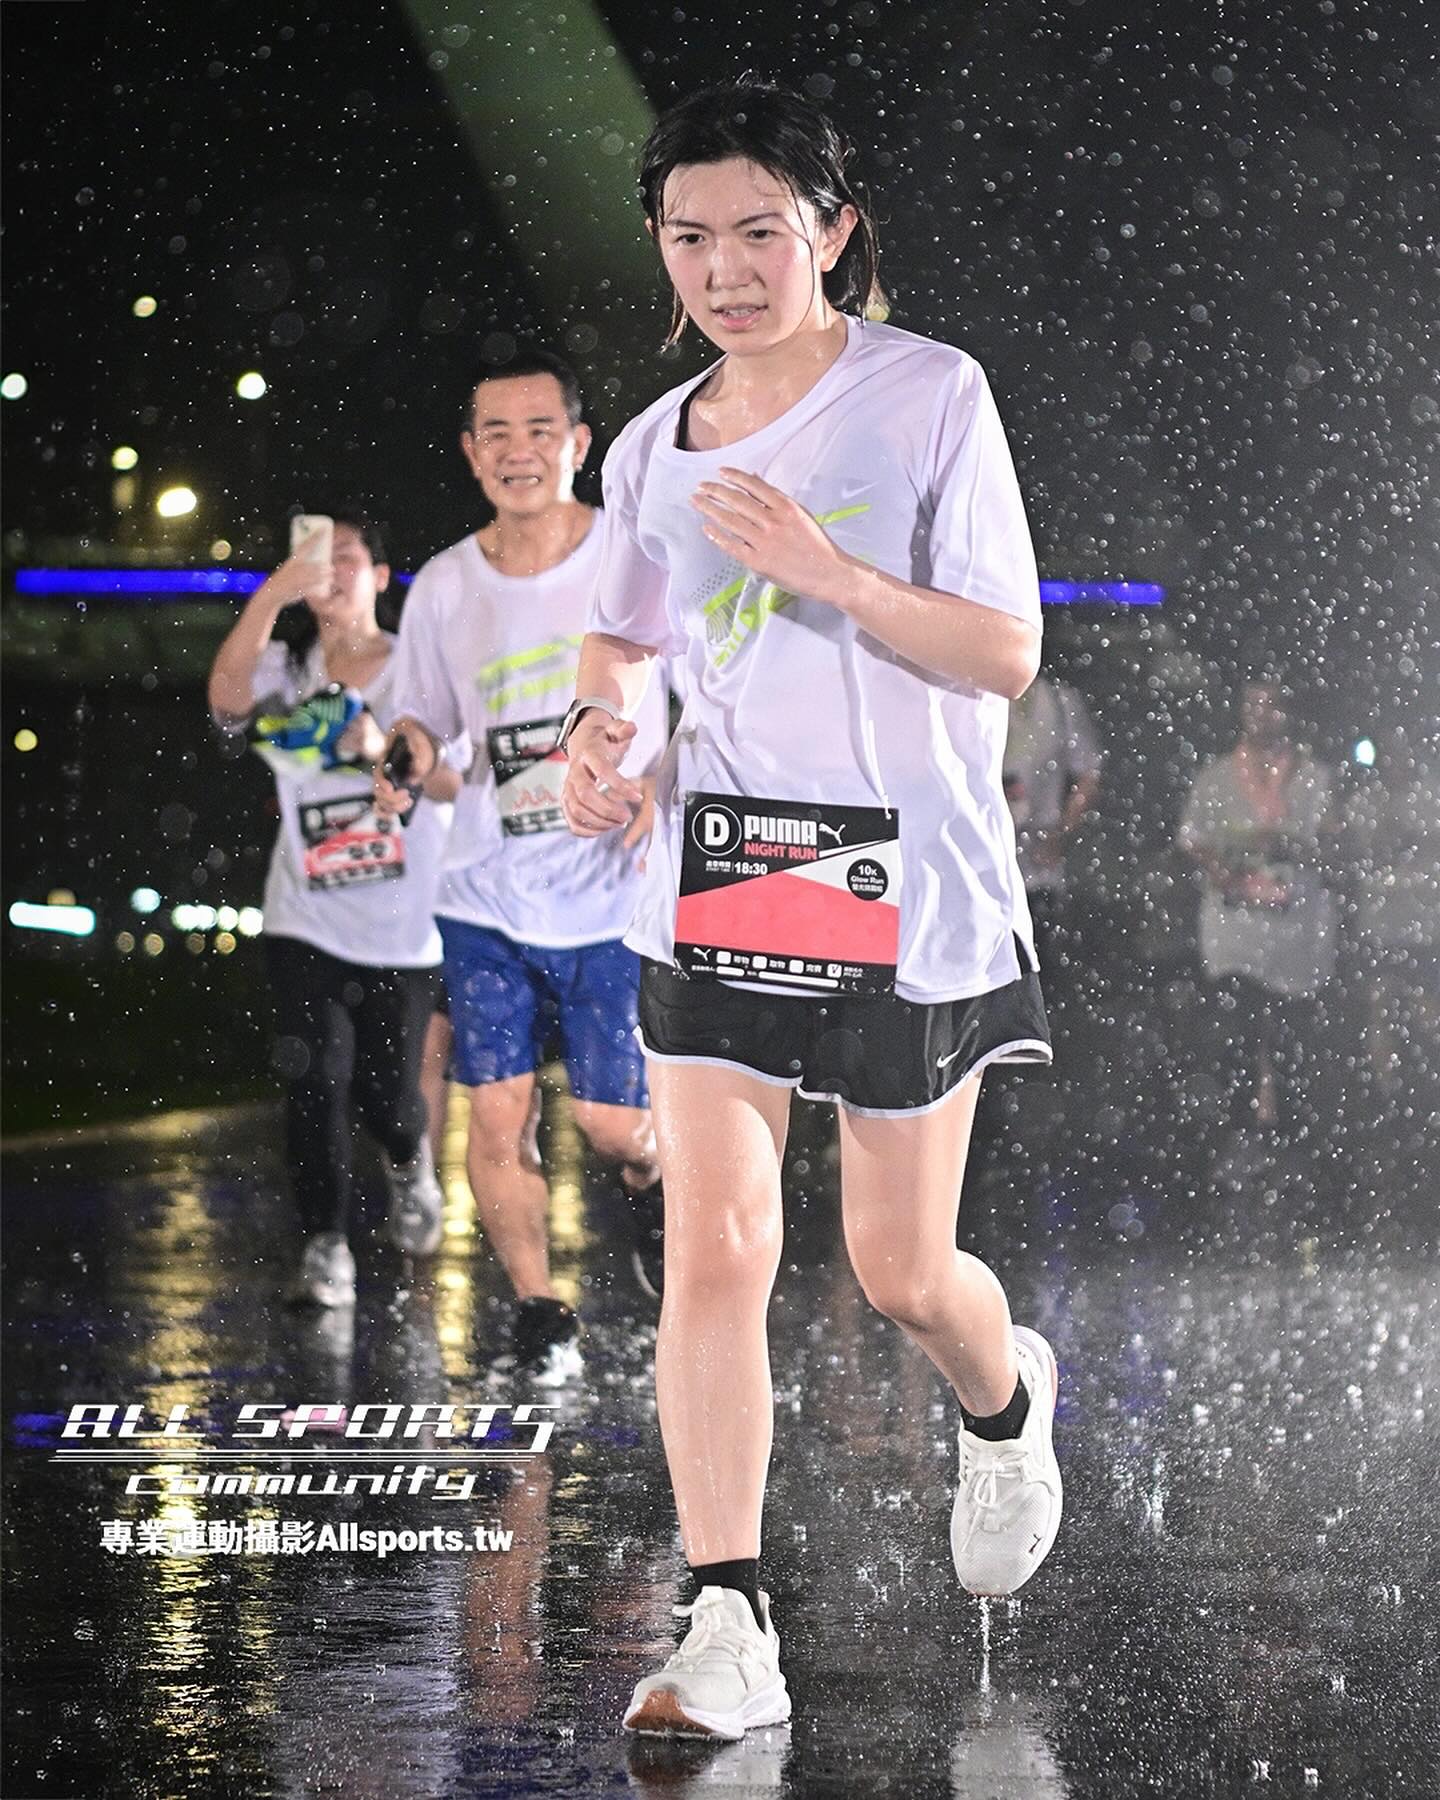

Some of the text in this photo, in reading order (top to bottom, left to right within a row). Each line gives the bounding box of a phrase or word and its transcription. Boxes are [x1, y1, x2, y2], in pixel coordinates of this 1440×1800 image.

[704, 812, 731, 846] D
[743, 814, 818, 846] PUMA
[743, 841, 818, 861] NIGHT RUN
[734, 861, 768, 876] 18:30
